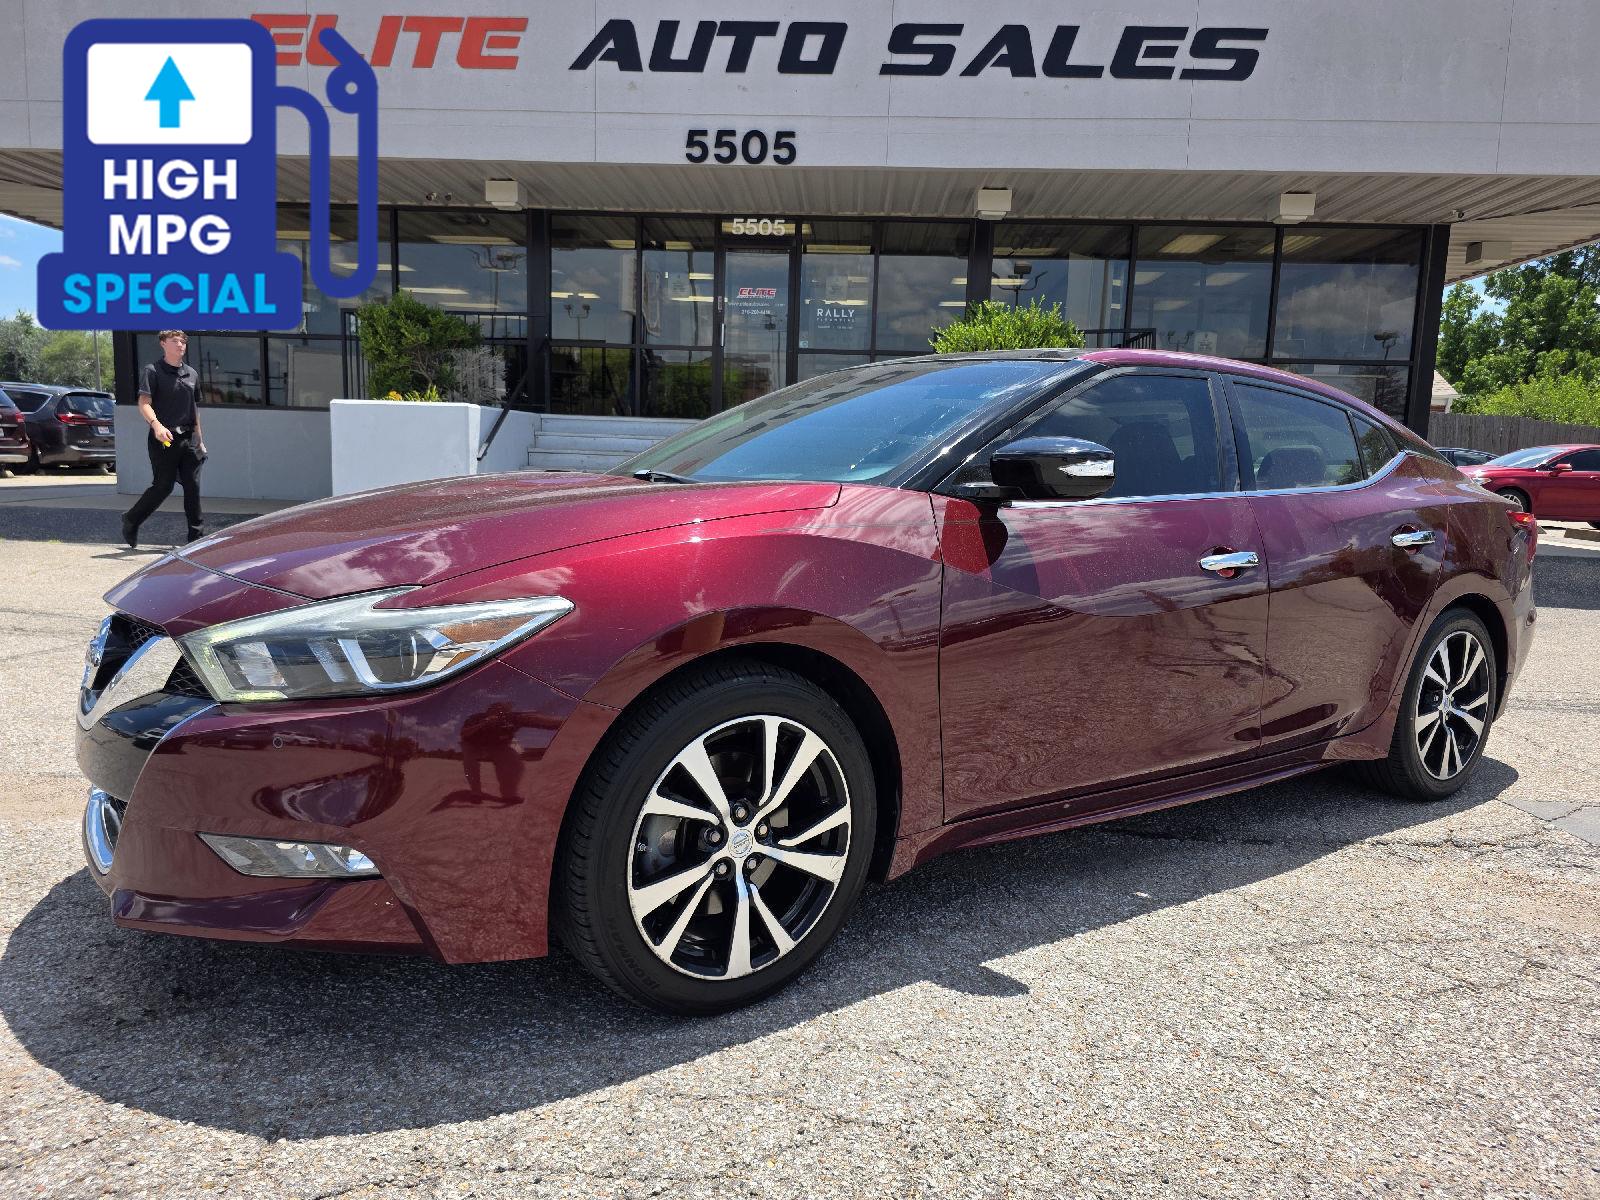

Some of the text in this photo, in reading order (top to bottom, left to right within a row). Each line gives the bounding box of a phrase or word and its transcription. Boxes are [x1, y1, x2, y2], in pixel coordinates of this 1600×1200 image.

[251, 14, 1269, 81] ELITE AUTO SALES
[686, 130, 797, 165] 5505
[731, 218, 786, 236] 5505
[738, 287, 777, 296] ELITE
[816, 308, 855, 318] RALLY
